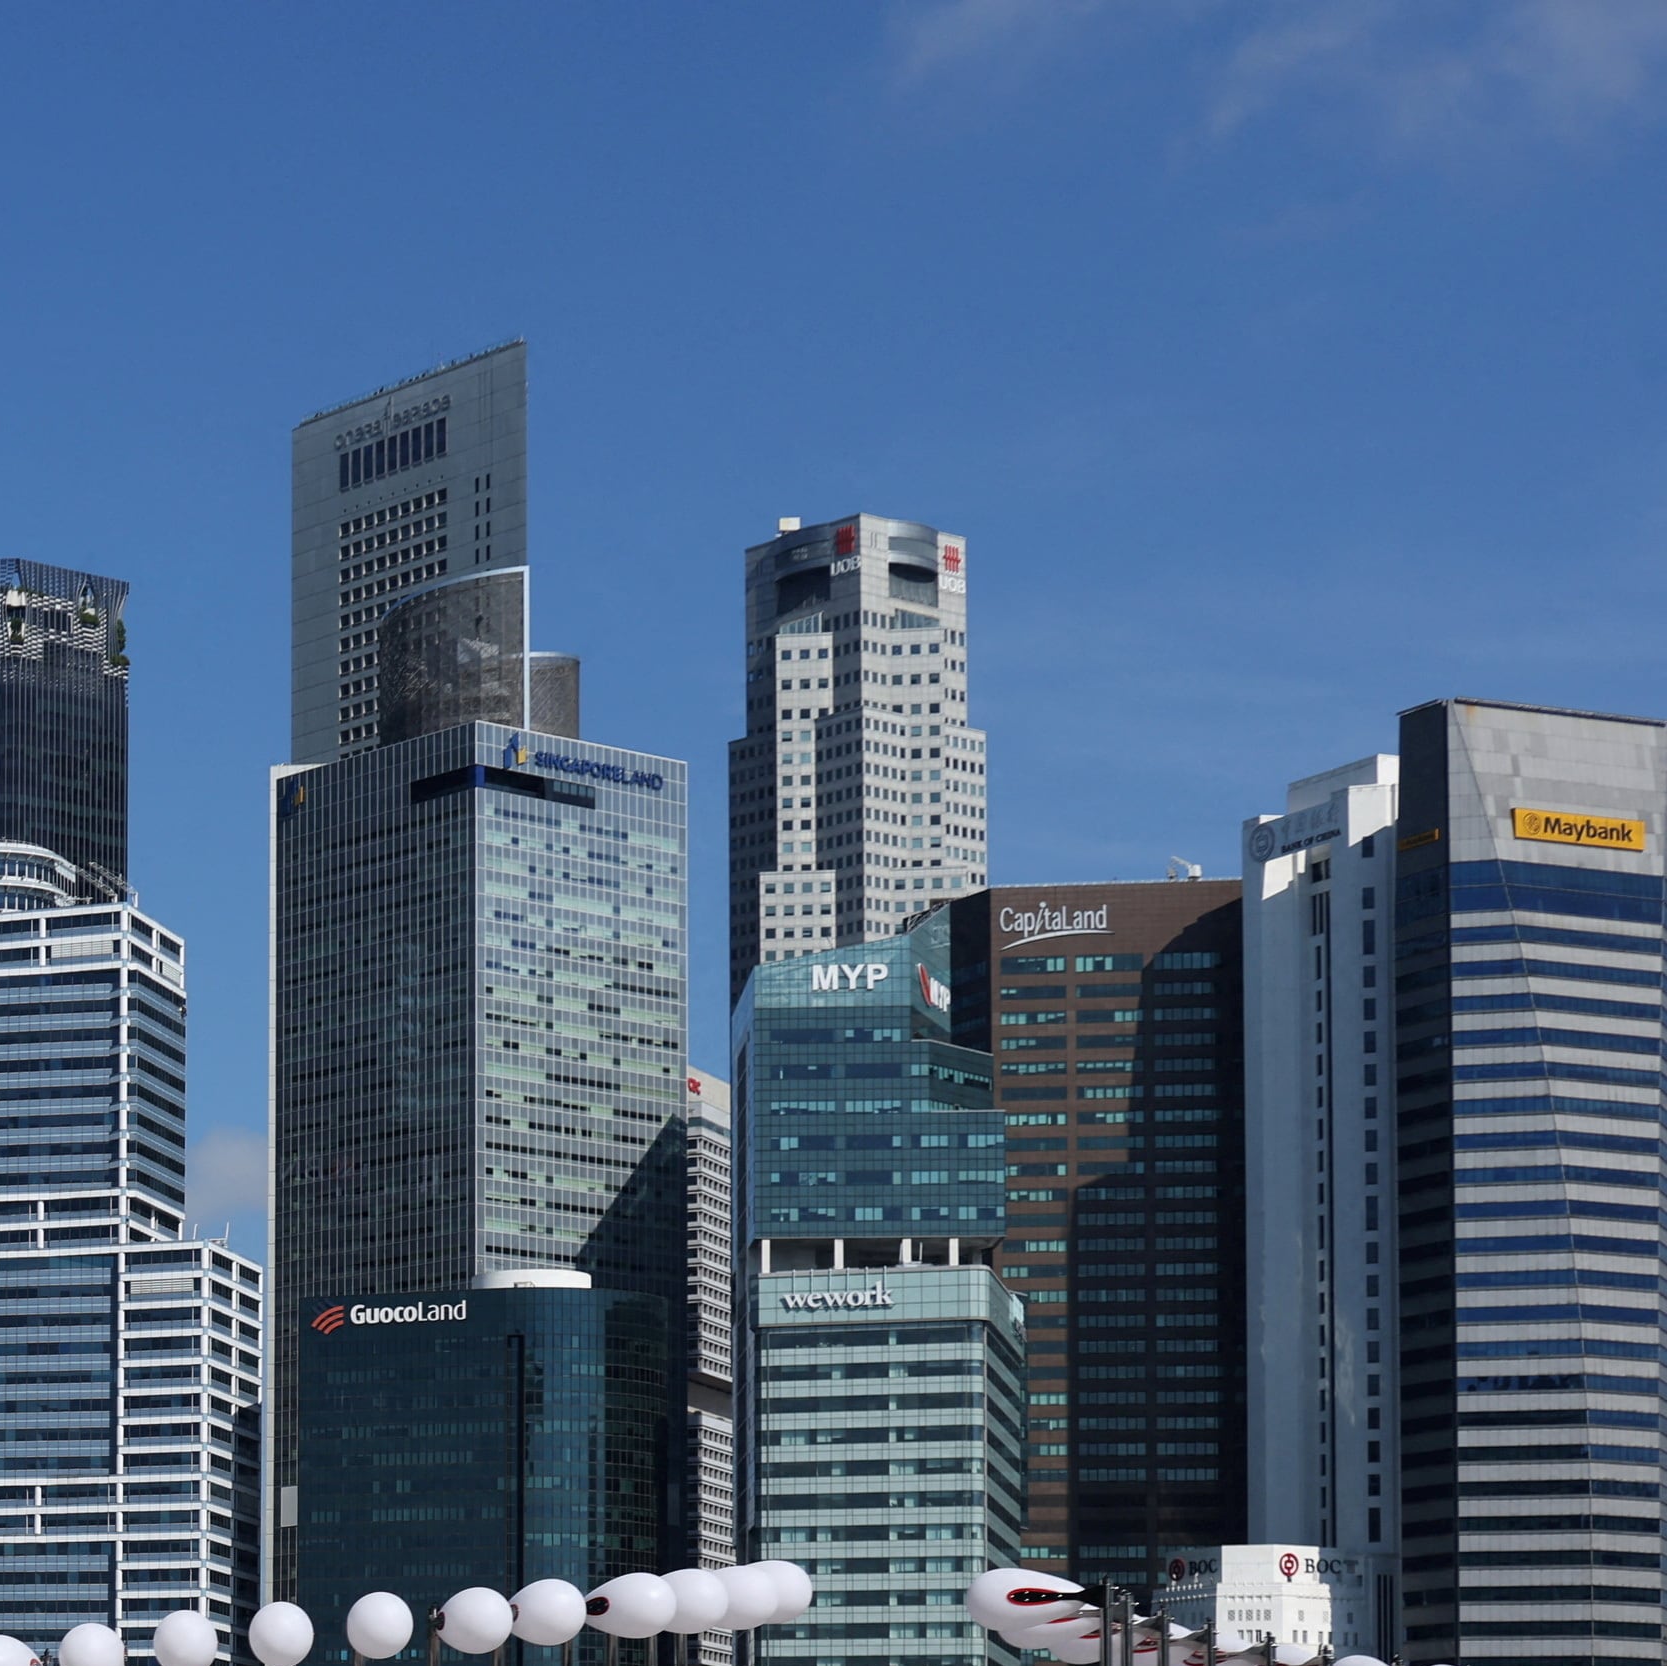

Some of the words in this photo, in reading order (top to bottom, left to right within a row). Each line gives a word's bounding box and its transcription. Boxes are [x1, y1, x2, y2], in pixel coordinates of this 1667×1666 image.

[830, 555, 862, 577] UOB
[940, 574, 966, 594] UOB
[535, 751, 664, 791] SINGAPORELAND
[1543, 817, 1634, 842] Maybank
[1000, 901, 1108, 938] CapitaLand
[811, 964, 889, 992] MYP
[783, 1280, 895, 1308] wework
[350, 1300, 467, 1325] GuocoLand
[1189, 1559, 1218, 1576] BOC
[1304, 1558, 1342, 1575] BOC
